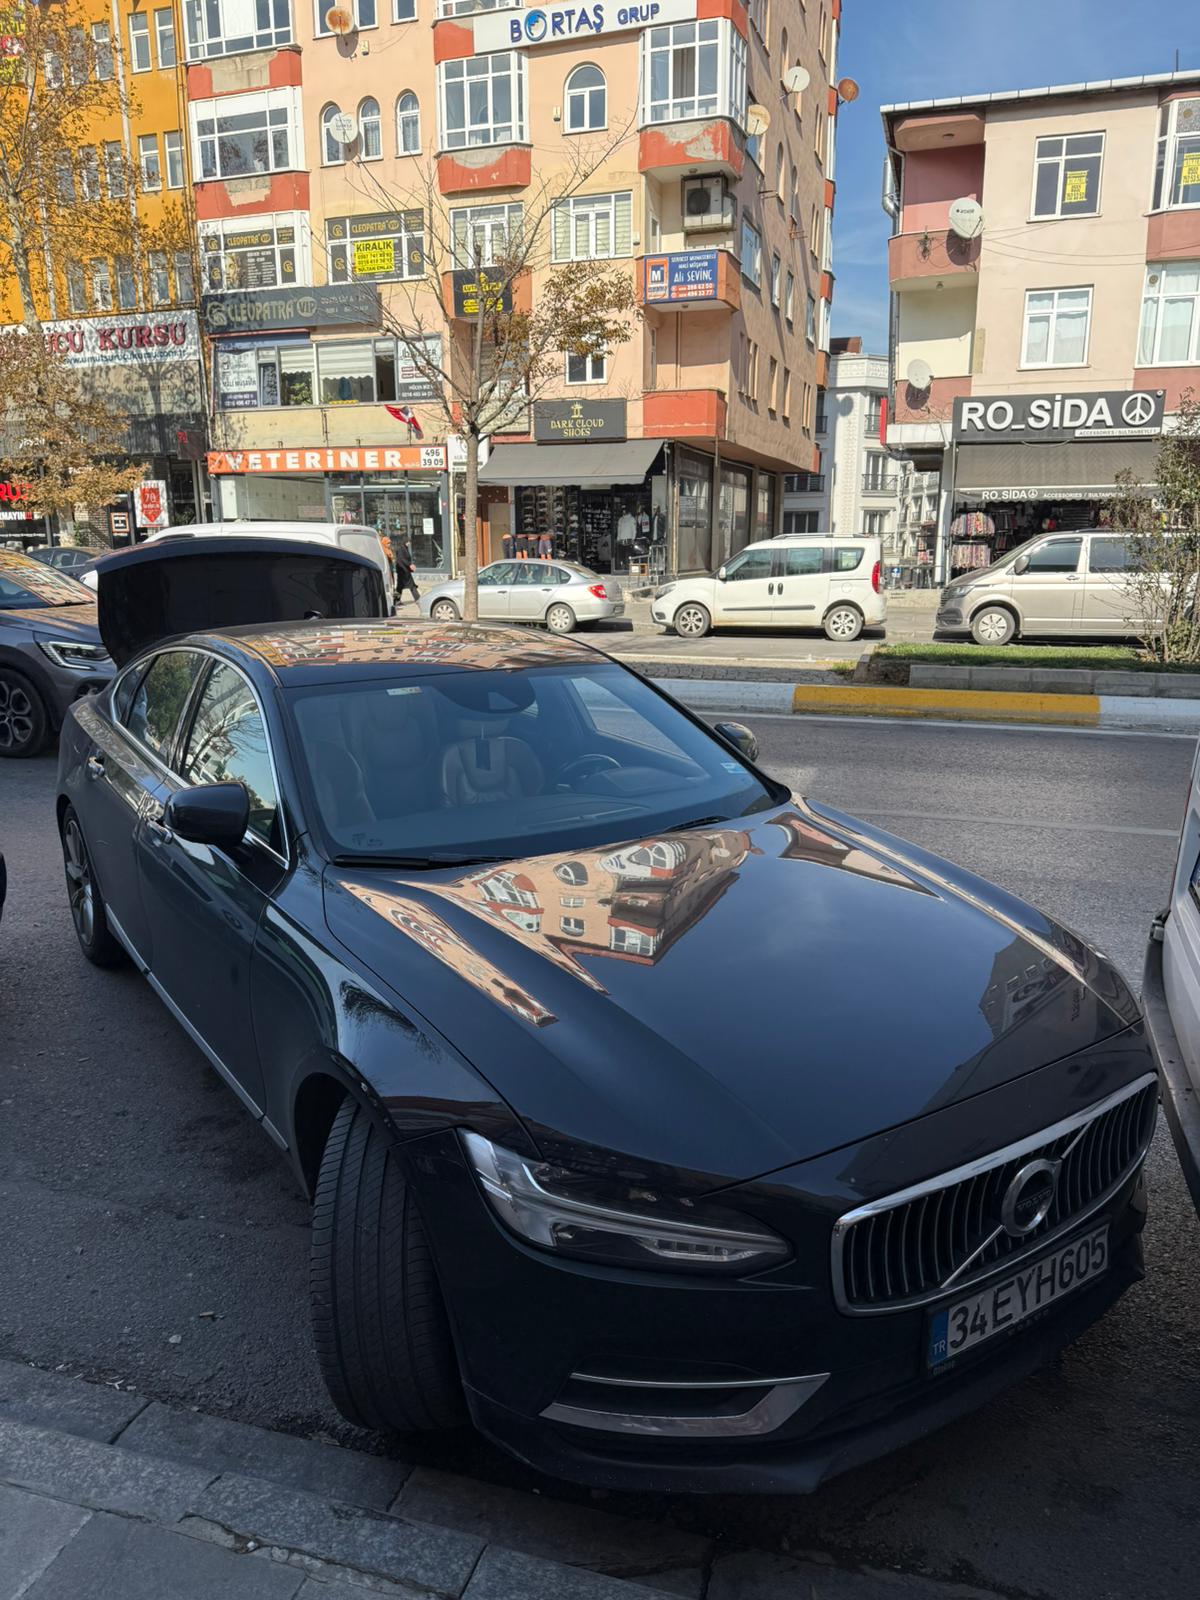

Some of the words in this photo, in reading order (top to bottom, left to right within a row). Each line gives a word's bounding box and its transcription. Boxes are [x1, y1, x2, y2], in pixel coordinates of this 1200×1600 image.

[510, 4, 604, 43] BORTAŞ
[617, 3, 660, 25] GRUP
[352, 222, 385, 233] CLEOPATRA
[227, 234, 259, 246] CLEOPATRA
[227, 300, 294, 322] CLEOPATRA
[96, 322, 187, 351] KURSU
[960, 394, 1114, 432] RO_SİDA
[550, 419, 574, 429] DARK
[575, 418, 604, 428] CLOUD
[563, 427, 591, 437] SHOES
[425, 449, 440, 457] 496
[422, 458, 433, 467] 39
[434, 458, 444, 466] 09
[932, 1340, 947, 1356] TR
